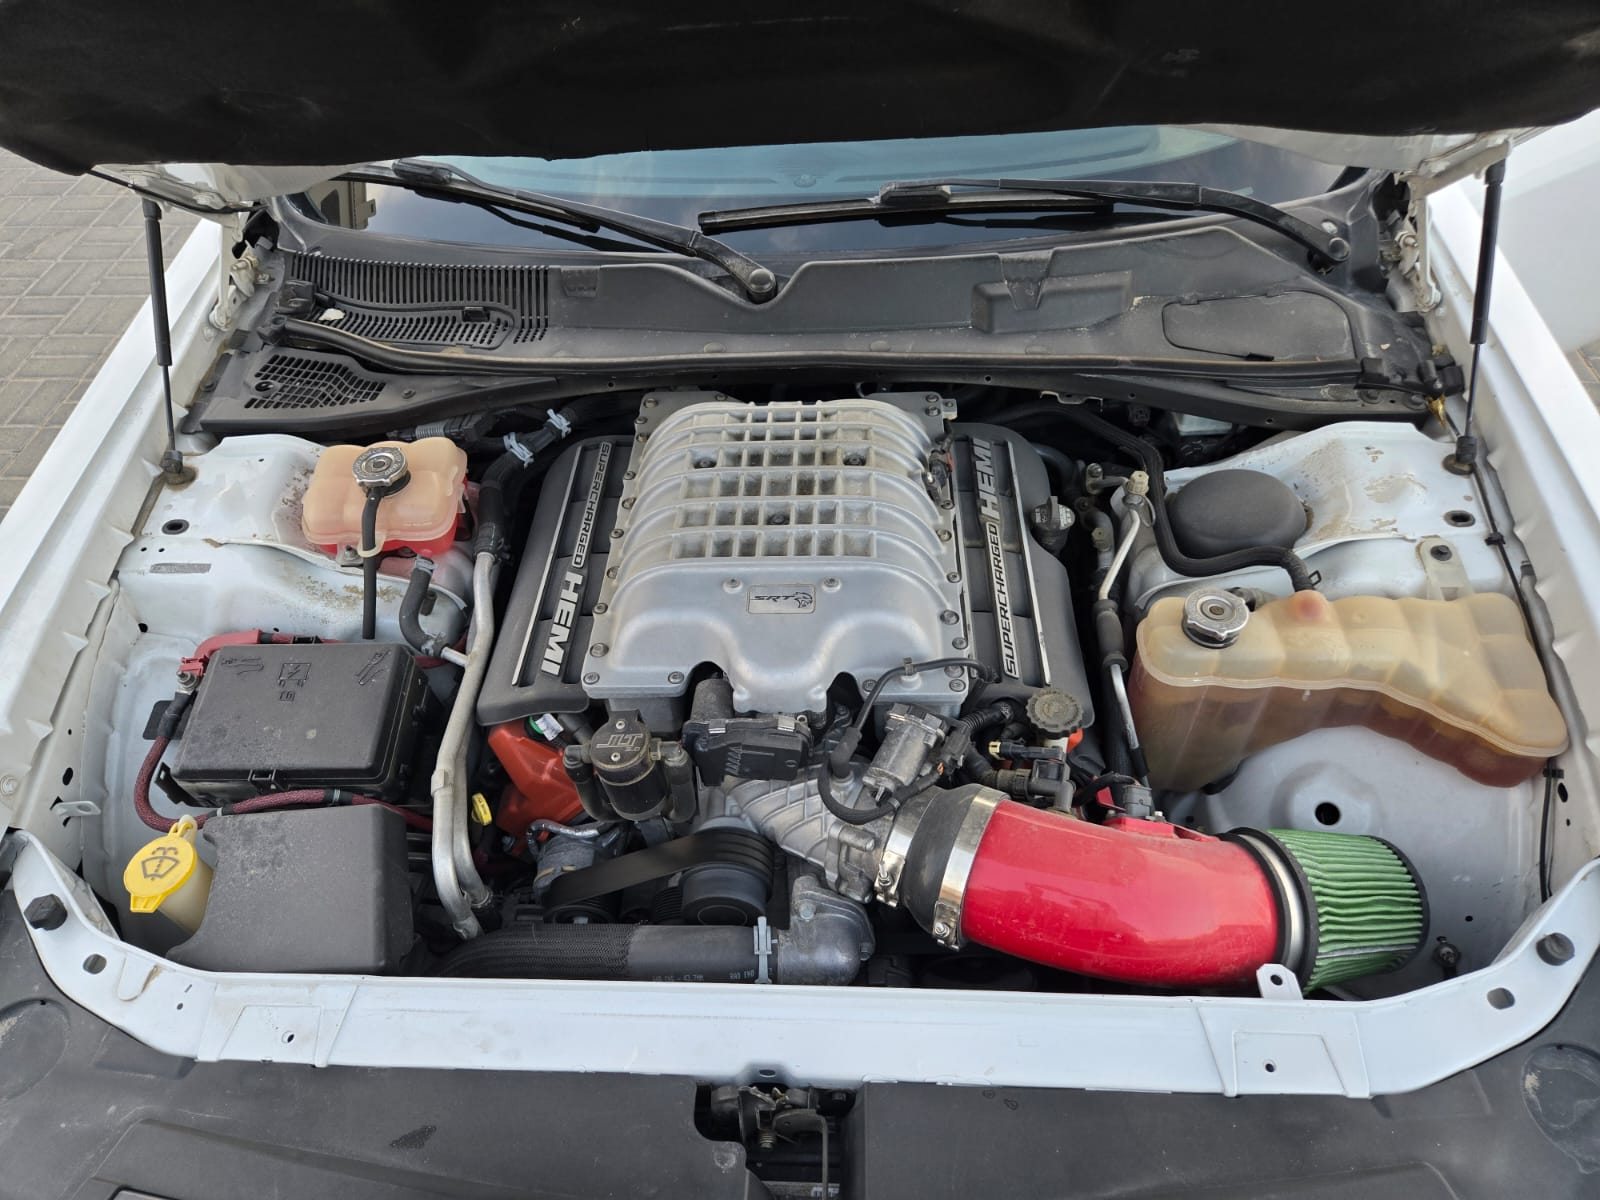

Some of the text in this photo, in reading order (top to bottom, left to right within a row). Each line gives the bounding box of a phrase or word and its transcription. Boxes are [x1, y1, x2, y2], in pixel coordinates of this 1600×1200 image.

[573, 442, 611, 567] SUPERCHARGED
[973, 437, 1018, 676] SUPERCHARGED HEMI
[541, 571, 584, 676] HEMI
